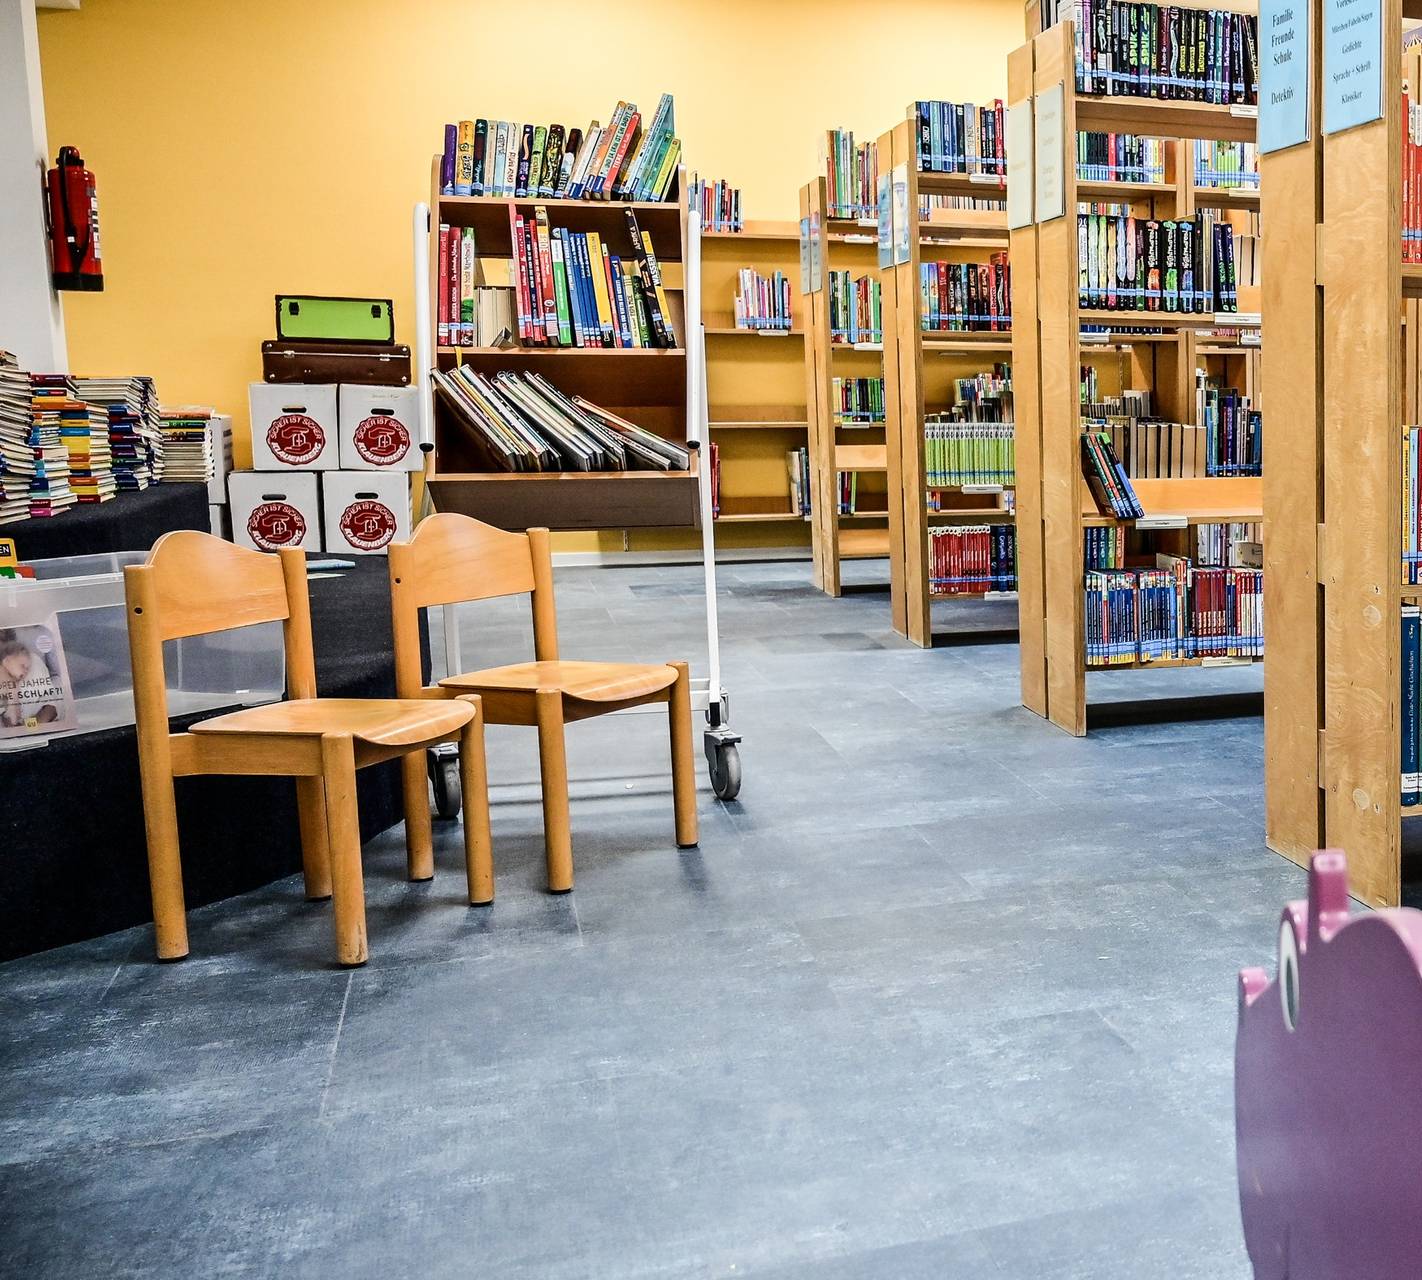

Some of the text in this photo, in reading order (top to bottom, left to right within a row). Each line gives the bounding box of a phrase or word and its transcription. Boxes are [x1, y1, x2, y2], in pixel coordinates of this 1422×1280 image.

[1272, 8, 1294, 28] Familie
[1271, 28, 1295, 47] Freunde
[1273, 49, 1292, 66] Schule
[1271, 86, 1294, 105] Detektiv
[630, 226, 642, 250] AFRIKA
[647, 254, 661, 285] WASSER!
[271, 418, 289, 439] SICHER
[302, 418, 322, 440] SICHER
[357, 419, 376, 440] SICHER
[388, 419, 407, 441] SICHER
[271, 442, 322, 464] KLAUENBERG
[357, 442, 407, 464] KLAUENBERG
[251, 506, 269, 528] SICHER
[282, 506, 303, 527] SICHER
[343, 505, 361, 527] SICHER
[374, 505, 393, 526] SICHER
[344, 527, 393, 549] KLAUENBERG
[20, 677, 51, 688] JAHRE
